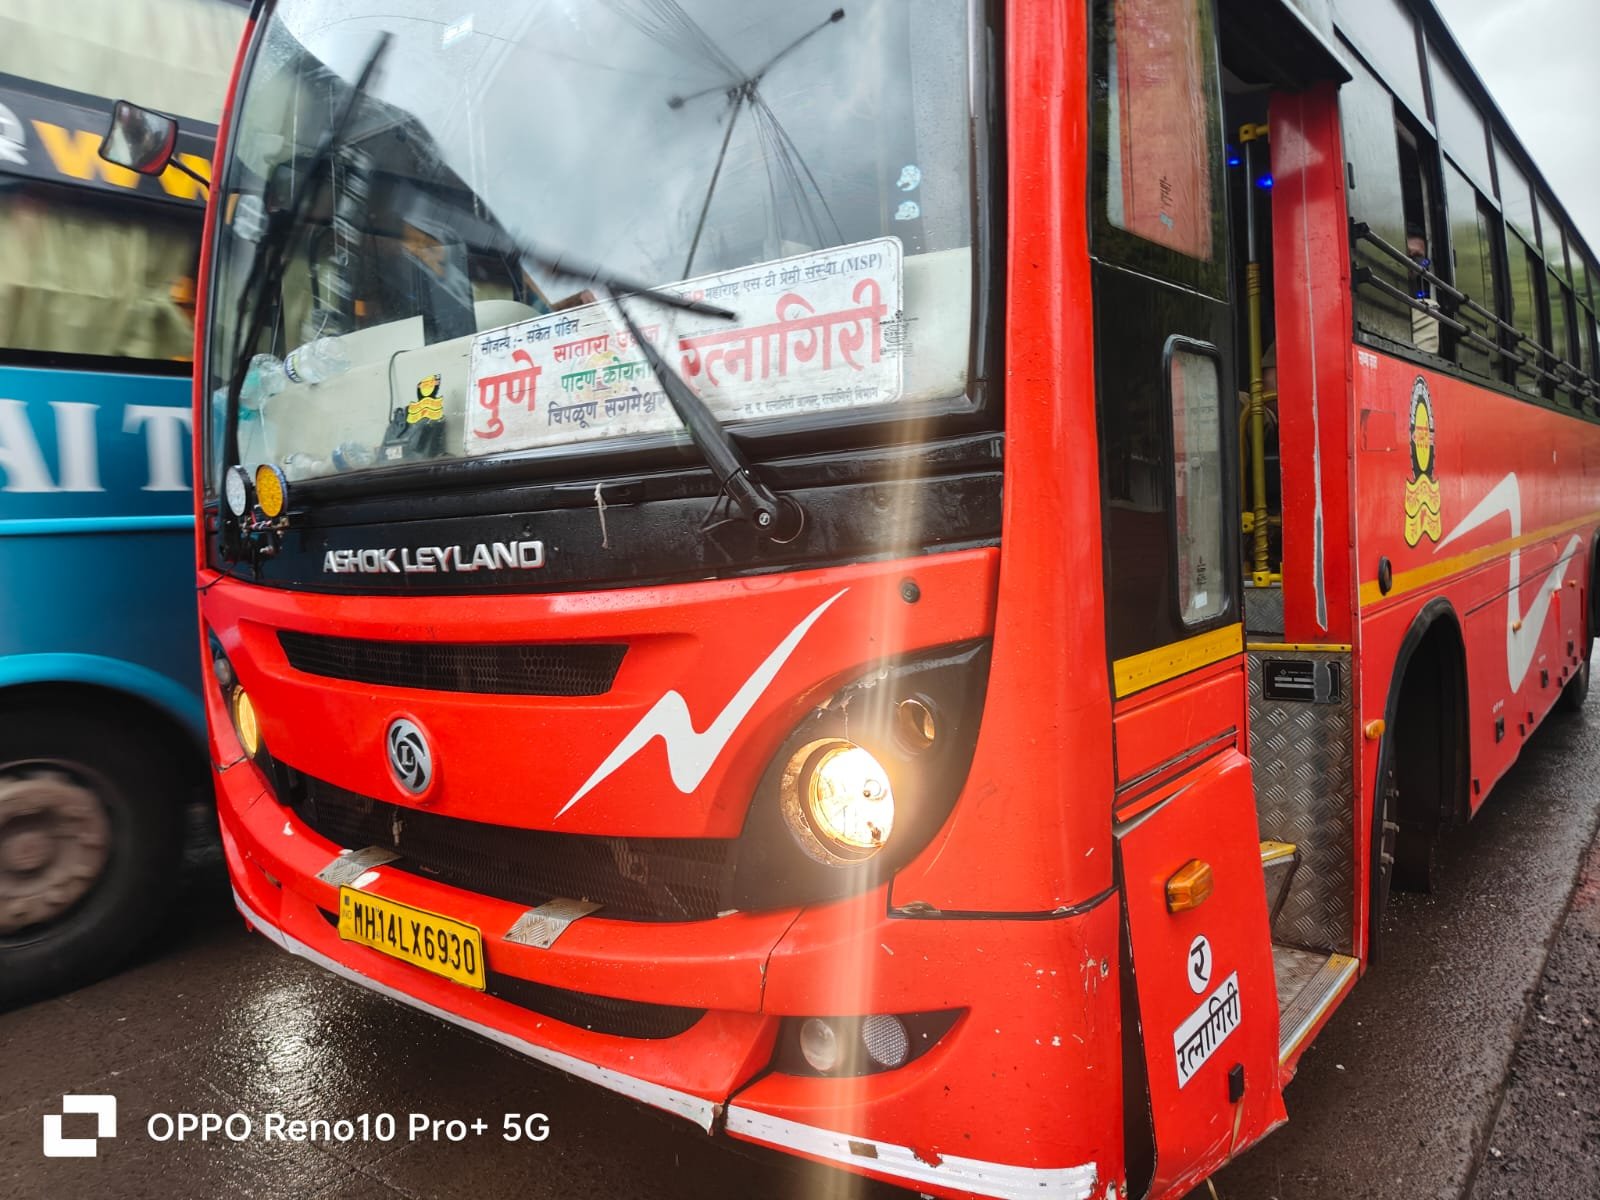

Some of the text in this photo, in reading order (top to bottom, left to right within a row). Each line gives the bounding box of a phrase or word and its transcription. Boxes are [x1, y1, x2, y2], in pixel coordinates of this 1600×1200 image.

[841, 253, 882, 275] (MSP)
[553, 334, 609, 363] सातारा
[678, 278, 888, 396] रत्नागिरी
[561, 356, 652, 393] पाटण कोयना
[473, 349, 542, 440] पुणे
[547, 400, 598, 429] चिपळूण
[323, 540, 545, 573] ASHOK LEYLAND
[354, 902, 476, 975] MH14LX6930
[1190, 940, 1208, 981] र
[1177, 982, 1238, 1077] रत्नागिरी
